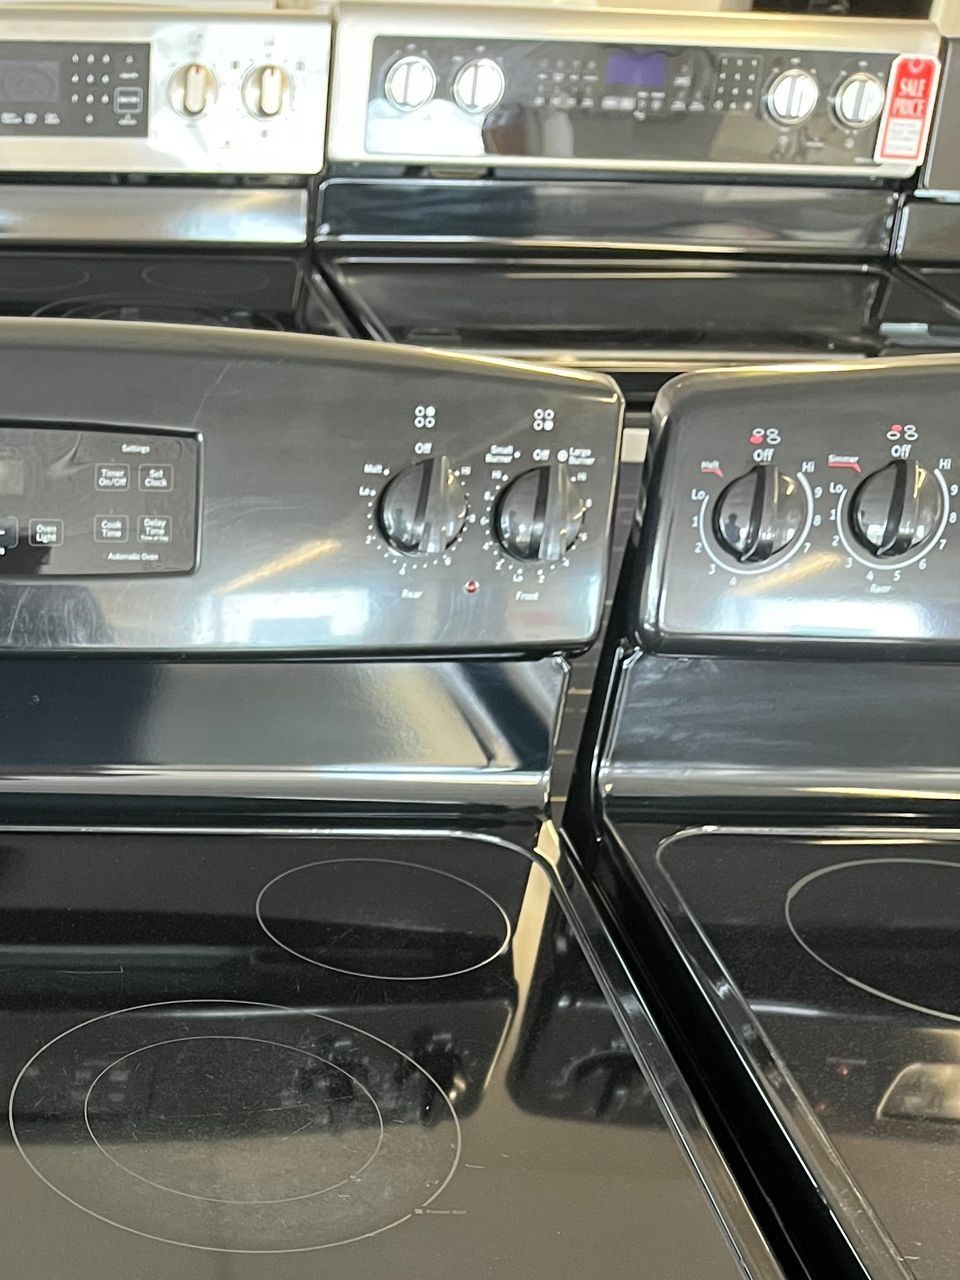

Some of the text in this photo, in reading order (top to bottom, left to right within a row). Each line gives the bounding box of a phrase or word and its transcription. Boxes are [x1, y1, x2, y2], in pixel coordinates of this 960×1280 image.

[900, 78, 927, 97] SALE
[122, 444, 150, 454] Settings
[415, 442, 432, 454] Off
[891, 445, 911, 459] Off
[533, 449, 550, 461] Off
[753, 449, 774, 462] Off
[802, 462, 815, 472] Hi
[940, 458, 951, 470] Hi
[101, 469, 125, 477] Timer
[150, 469, 163, 478] Set
[99, 477, 127, 486] On/Off
[145, 478, 167, 487] Clock
[359, 486, 370, 496] Lo
[814, 487, 822, 498] 9
[830, 482, 843, 493] Lo
[950, 485, 958, 496] 9
[691, 489, 705, 500] Lo
[830, 509, 836, 520] 1
[949, 512, 957, 523] 8
[101, 520, 122, 528] Cook
[144, 519, 166, 528] Delay
[692, 516, 698, 527] 1
[813, 515, 821, 526] 8
[36, 524, 57, 533] Oven
[102, 529, 122, 537] Time
[36, 533, 56, 543] Light
[832, 536, 839, 546] 2
[695, 543, 702, 553] 2
[804, 543, 811, 553] 7
[940, 539, 947, 550] 7
[108, 552, 141, 560] Automatic
[846, 557, 852, 568] 3
[919, 559, 926, 569] 6
[708, 564, 715, 574] 3
[866, 570, 874, 580] 4
[893, 570, 901, 581] 5
[729, 576, 737, 586] 4
[402, 589, 423, 598] Rear
[516, 591, 539, 600] Front
